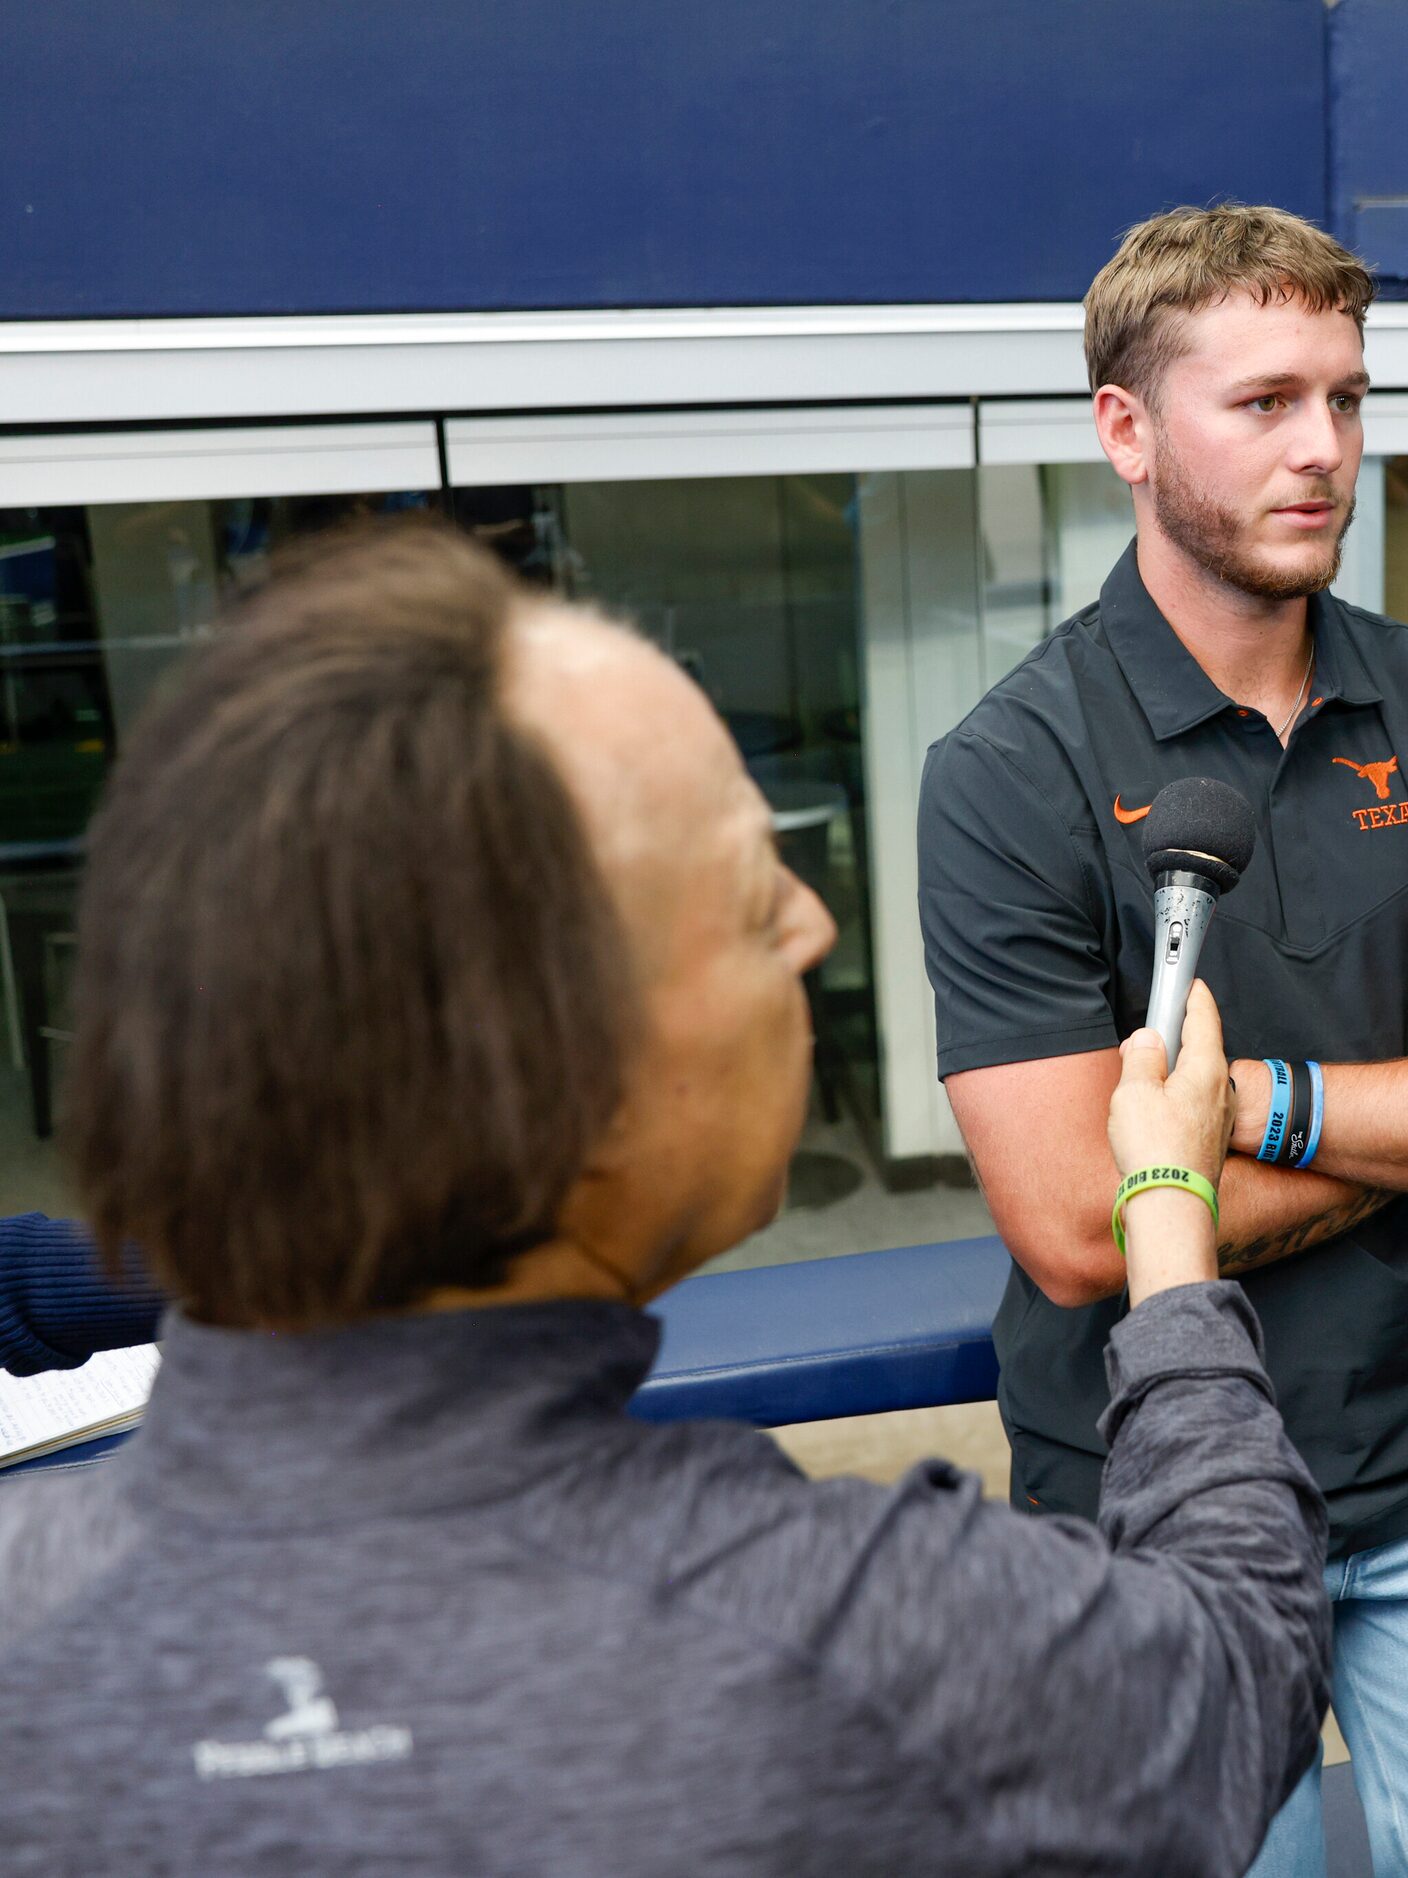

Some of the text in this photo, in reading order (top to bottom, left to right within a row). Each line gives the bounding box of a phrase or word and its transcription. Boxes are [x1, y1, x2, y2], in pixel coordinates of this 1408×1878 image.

[1268, 1111, 1284, 1142] 2023
[1127, 1170, 1147, 1189] BIG
[1151, 1167, 1189, 1182] 2023
